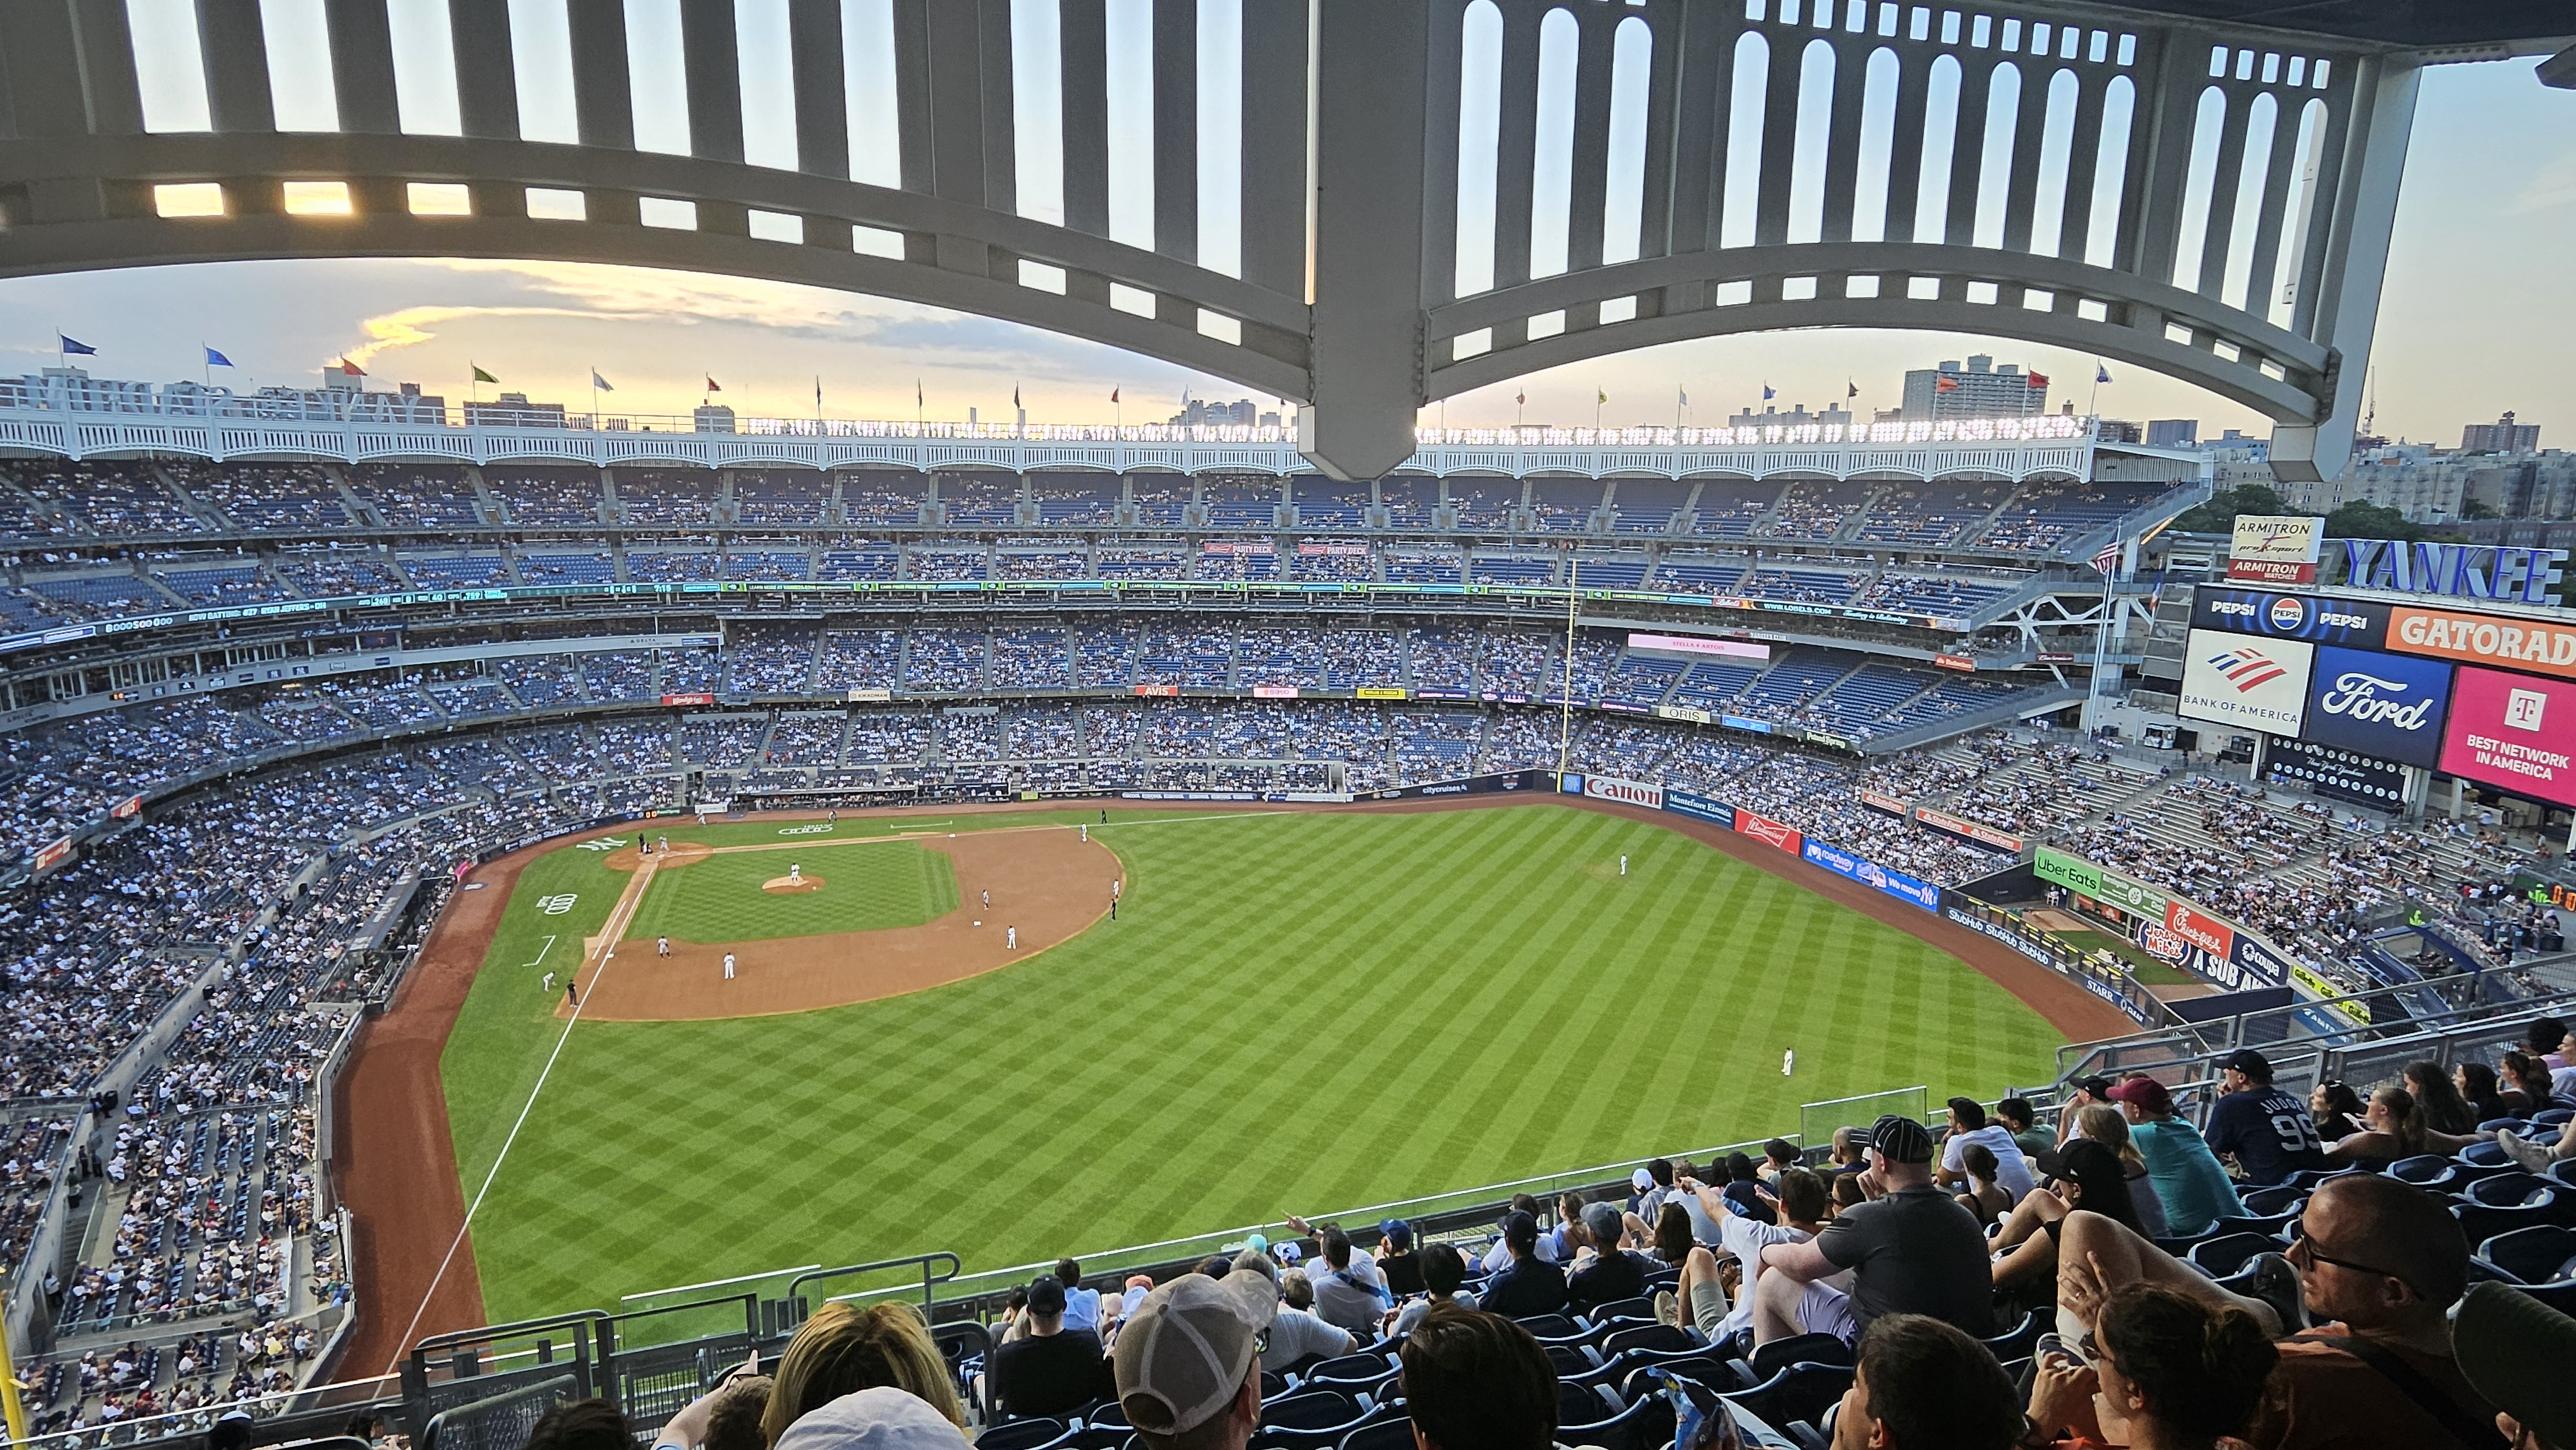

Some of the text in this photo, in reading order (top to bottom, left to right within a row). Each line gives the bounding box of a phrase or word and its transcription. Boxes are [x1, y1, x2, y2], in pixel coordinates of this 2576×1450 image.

[2237, 522, 2311, 534] ARMITRON
[1327, 546, 1348, 554] PARTY
[2234, 561, 2300, 574] ARMITRON
[2264, 572, 2297, 580] WATCHES
[2344, 538, 2564, 604] YANKEE
[2211, 601, 2256, 616] PEPSI
[2274, 609, 2300, 619] PEPSI
[2320, 612, 2367, 630] PEPSI
[2400, 616, 2576, 666] GATORAD
[1144, 687, 1170, 695] AVIS
[2322, 672, 2434, 731] Ford
[1669, 708, 1701, 721] ORIS
[2184, 695, 2298, 724] BANK OF AMERICA
[2306, 757, 2322, 767] New
[2467, 734, 2570, 769] BEST NETWORK
[2476, 751, 2553, 781] IN AMERICA
[1422, 785, 1461, 794] citycruises
[1587, 778, 1660, 805] Canon
[1669, 793, 1707, 810] Montefiore
[1707, 803, 1732, 818] Einstein
[519, 834, 542, 847] StubHub
[544, 826, 569, 838] StubHub
[1750, 821, 1784, 842] Budweiser
[1821, 849, 1855, 871] roadway
[2038, 856, 2098, 890] Uber Eats
[1888, 876, 1900, 889] We
[1900, 883, 1922, 899] move
[1948, 910, 1984, 931] StubHub
[1985, 925, 2018, 948] StubHub
[2146, 923, 2183, 948] Jersey
[2173, 913, 2222, 953] Chick-fil-A
[2018, 941, 2049, 965] StubHub
[2193, 949, 2204, 972] A
[2207, 954, 2239, 988] SUB
[2254, 952, 2280, 977] coupa
[2295, 969, 2316, 989] Gillette
[2087, 979, 2114, 1003] STARR
[2127, 1005, 2144, 1023] CLEAR
[2260, 1098, 2303, 1115] JUDGE
[2271, 1113, 2321, 1152] 99
